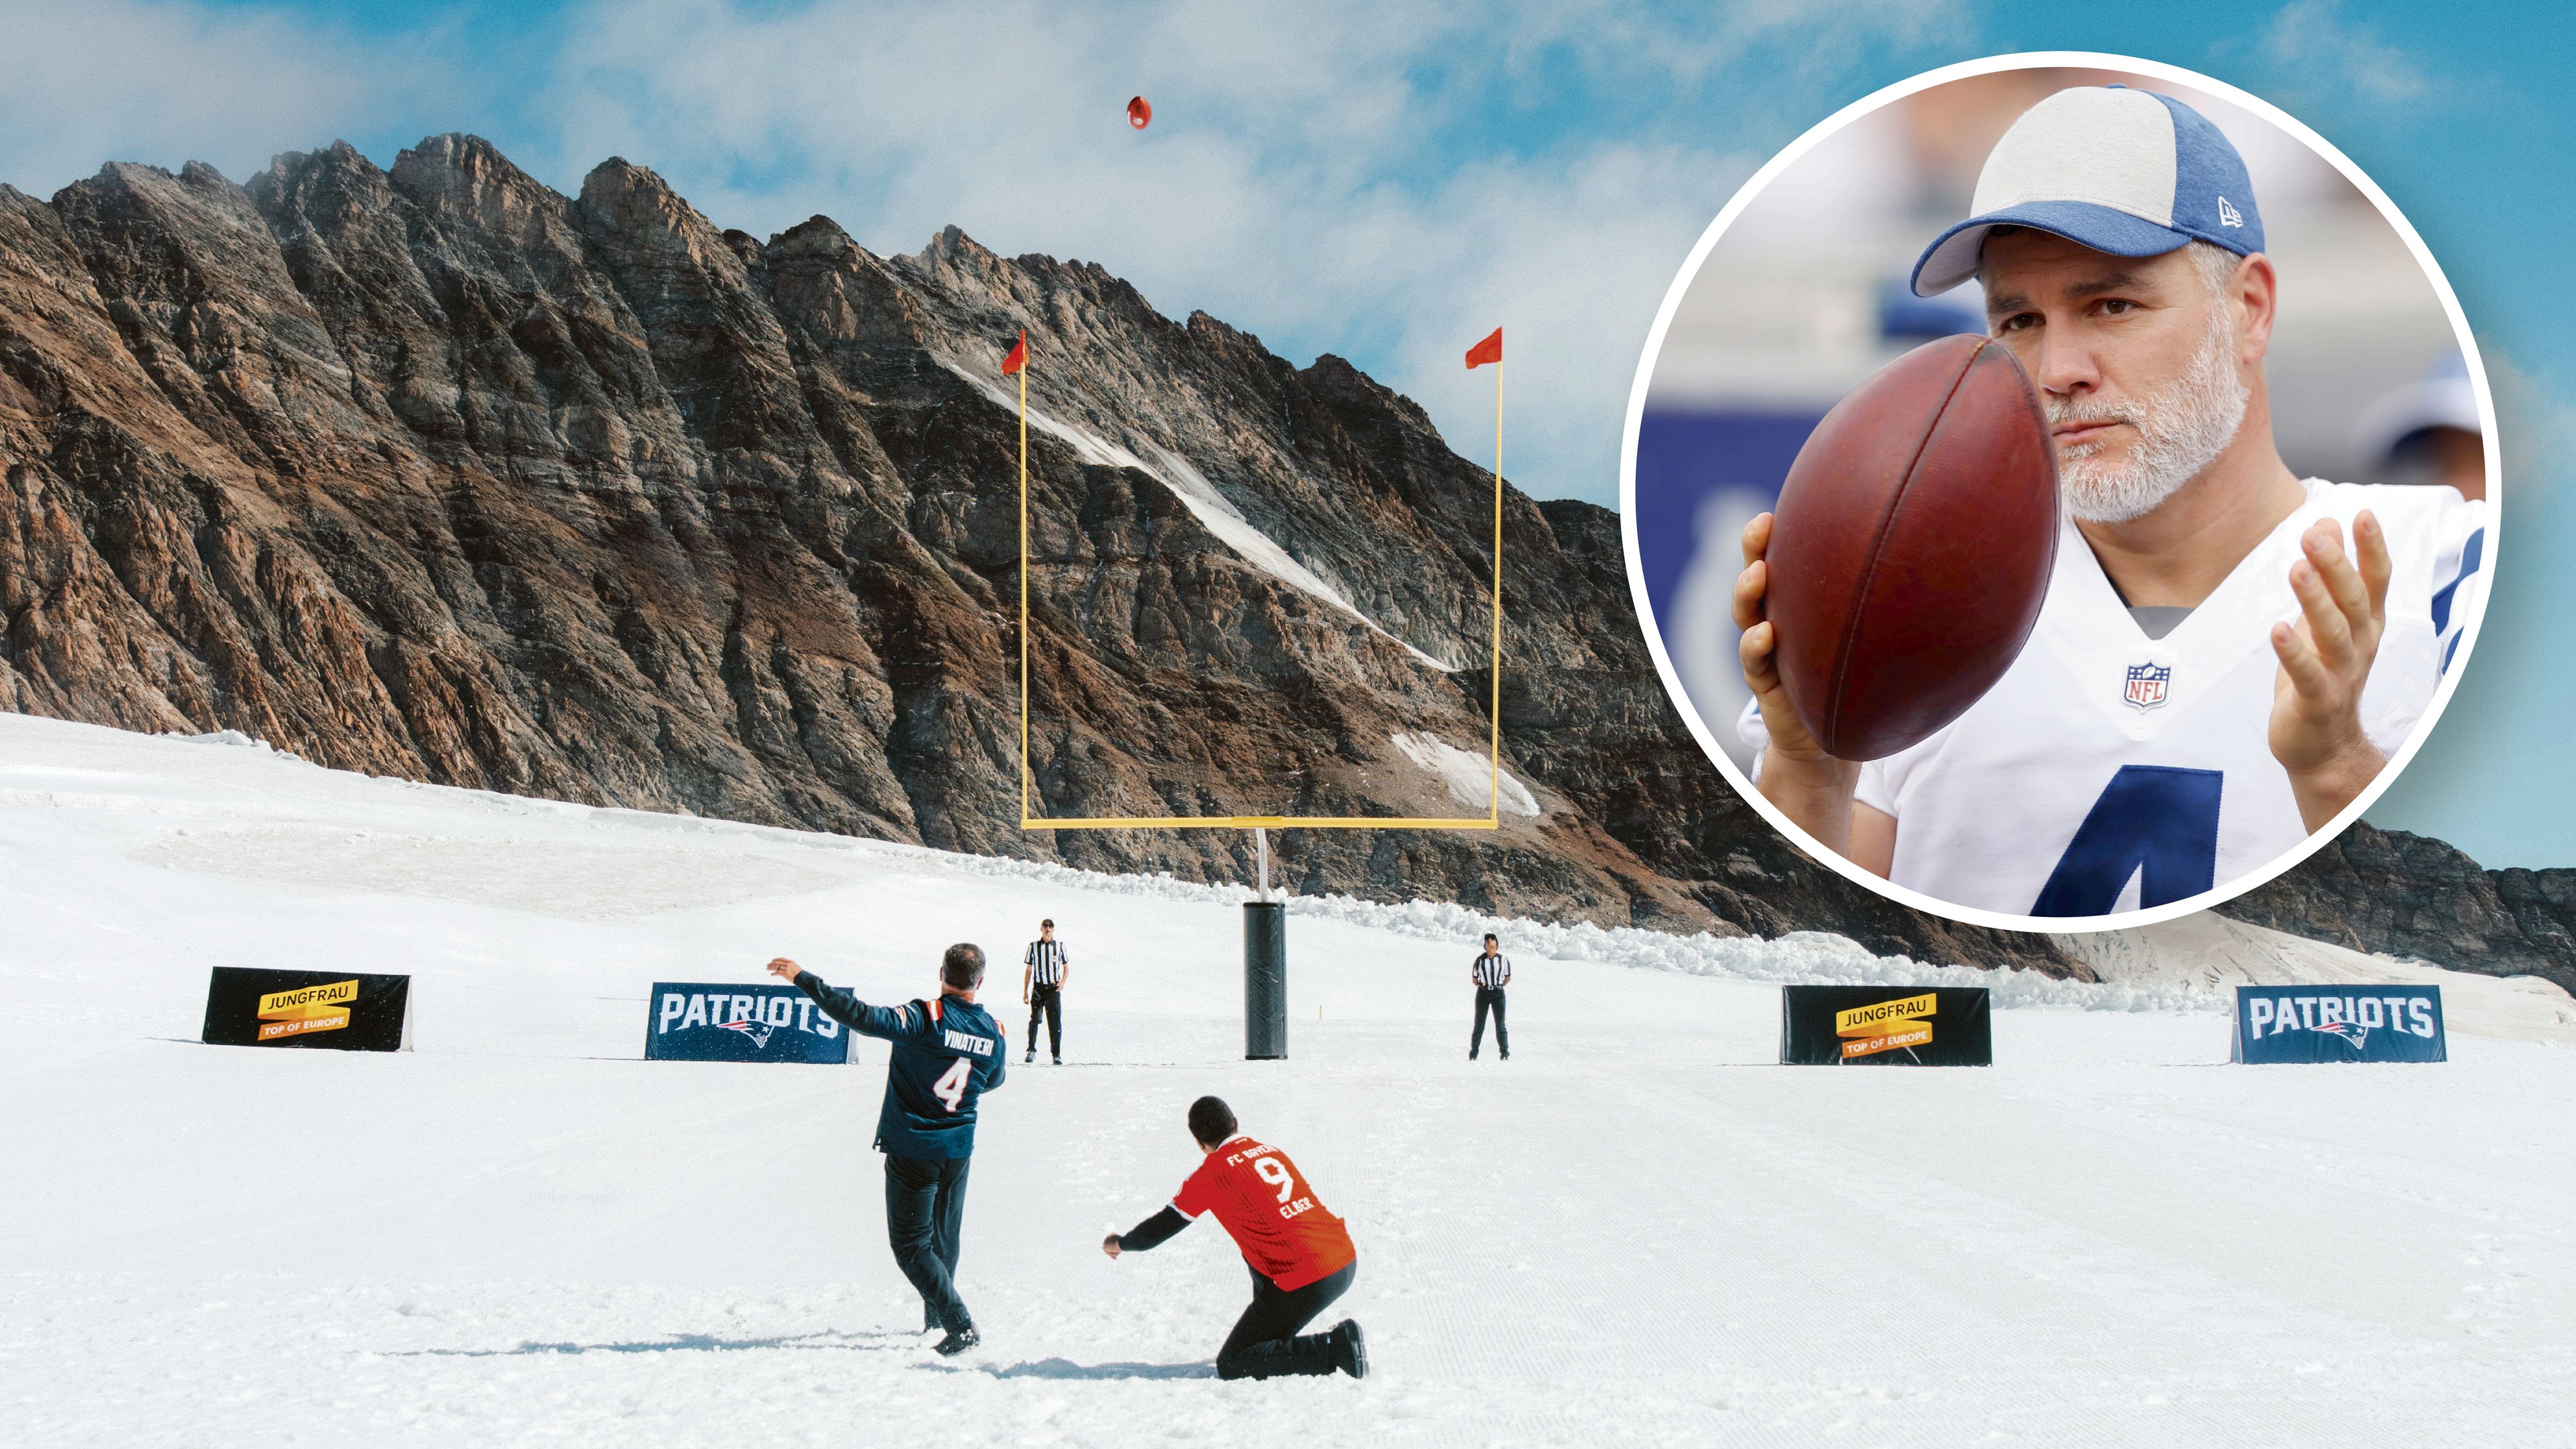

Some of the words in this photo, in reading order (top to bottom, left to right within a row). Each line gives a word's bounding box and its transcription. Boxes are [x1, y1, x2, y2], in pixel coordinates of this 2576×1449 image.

[2128, 681, 2163, 702] NFL
[2031, 764, 2224, 918] 4
[268, 985, 349, 1009] JUNGFRAU
[265, 1025, 284, 1036] TOP
[288, 1022, 301, 1032] OF
[303, 1016, 345, 1030] EUROPE
[1846, 999, 1926, 1027] JUNGFRAU
[2249, 997, 2435, 1039] PATRIOTS
[944, 1029, 994, 1057] VINATIERI
[1846, 1043, 1868, 1054] TOP
[1870, 1039, 1884, 1049] OF
[1888, 1031, 1927, 1045] EUROPE
[933, 1057, 972, 1112] 4
[1226, 1153, 1244, 1167] FC
[1254, 1157, 1293, 1204] 9
[1279, 1197, 1314, 1219] ELBER
